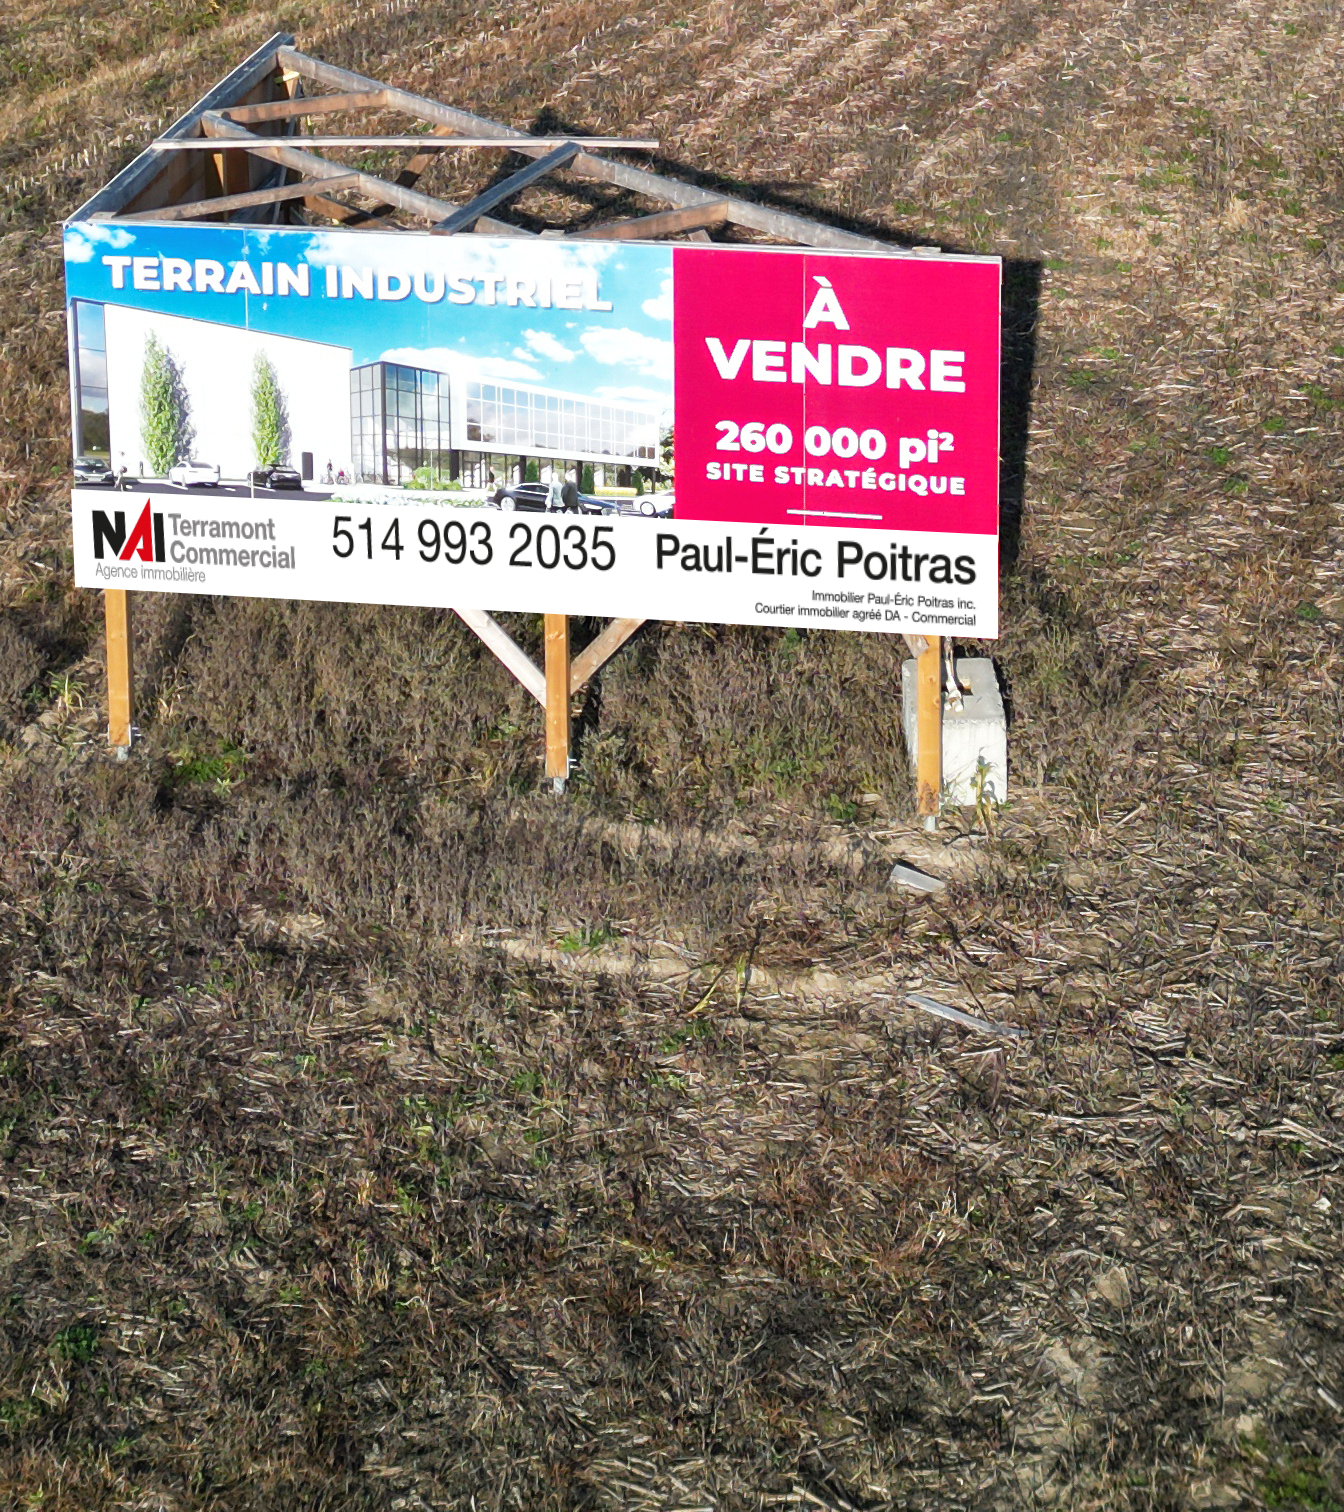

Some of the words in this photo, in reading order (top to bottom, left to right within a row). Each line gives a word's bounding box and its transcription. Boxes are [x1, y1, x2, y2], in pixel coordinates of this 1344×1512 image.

[102, 256, 310, 298] TERRAIN
[326, 265, 613, 311] INDUSTRIEL
[803, 276, 850, 331] À
[705, 337, 966, 393] VENDRE
[716, 421, 792, 454] 260
[805, 426, 886, 460] 000
[899, 430, 954, 469] pi²
[706, 462, 764, 483] SITE
[774, 465, 966, 497] STRATÉGIQUE
[92, 497, 166, 563] NAI
[168, 513, 275, 540] Terramont
[333, 515, 404, 560] 514
[418, 519, 493, 565] 993
[509, 523, 616, 571] 2035
[96, 563, 138, 580] Agence
[141, 565, 206, 583] immobilière
[170, 540, 296, 569] Commercial
[656, 528, 822, 578] Paul-Éric
[838, 540, 977, 585] Poitras
[755, 602, 794, 615] Courtier
[798, 605, 849, 619] immobilier
[852, 608, 882, 622] agréé
[885, 610, 901, 622] DA
[912, 611, 976, 626] Commercial
[812, 590, 864, 603] Immobilier
[867, 592, 914, 606] Paul-Éric
[917, 595, 954, 608] Poitras
[957, 597, 976, 609] inc.
